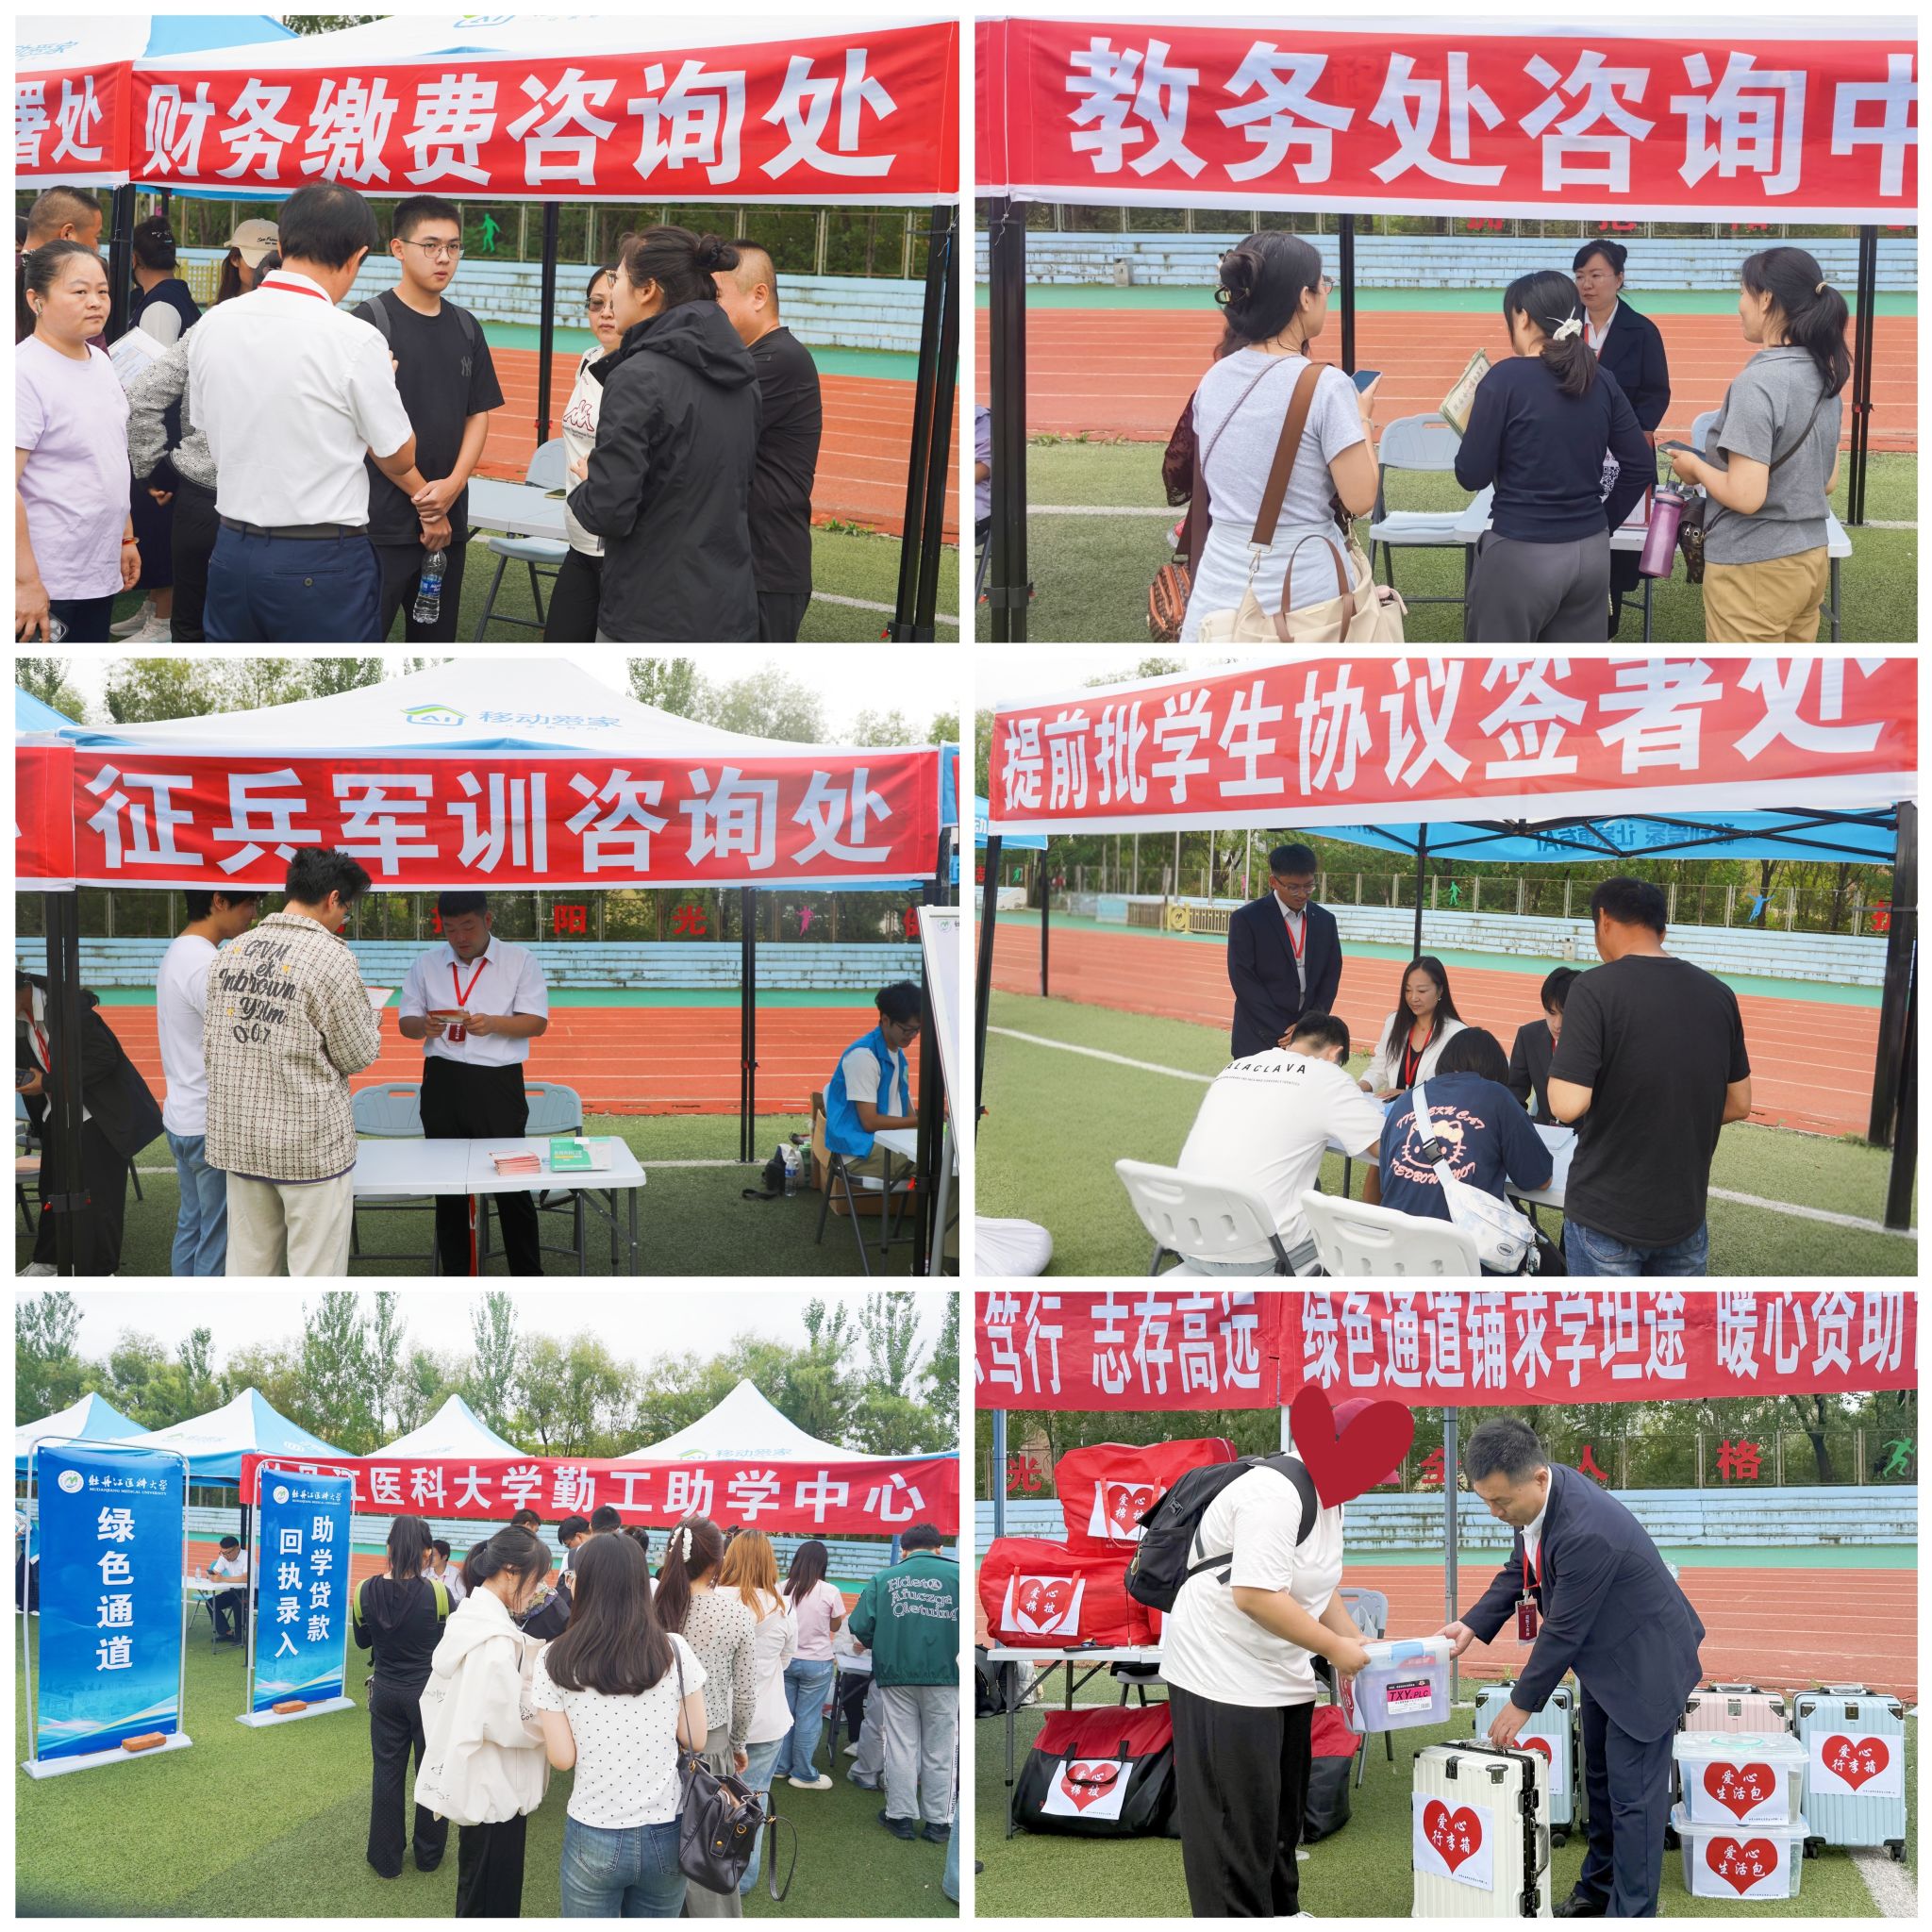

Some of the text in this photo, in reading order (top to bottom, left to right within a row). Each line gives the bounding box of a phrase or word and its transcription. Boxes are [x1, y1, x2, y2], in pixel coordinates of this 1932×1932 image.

[142, 48, 898, 186] 财务缴费咨询处
[1002, 658, 1887, 811] 提前批学生协议签署处
[84, 764, 893, 875] 征兵军训咨询处
[553, 905, 708, 935] 阳 光
[974, 1291, 1918, 1394] 笃行 志存高远 绿色通道铺求学坦途 暖心资助
[1007, 1456, 1041, 1491] 光
[1716, 1440, 1762, 1479] 格
[1119, 1493, 1146, 1507] 爱心
[96, 1507, 135, 1672] 绿色通道
[307, 1515, 334, 1642] 助学贷款
[275, 1528, 303, 1658] 回执录入
[1029, 1587, 1058, 1600] 爱心
[1025, 1600, 1056, 1614] 棉被
[1839, 1744, 1873, 1758] 爱心
[1832, 1758, 1876, 1774] 行李箱
[1722, 1770, 1758, 1785] 爱心
[1716, 1786, 1764, 1801] 生活包
[1437, 1813, 1467, 1832] 爱心
[1432, 1829, 1471, 1855] 行李箱
[1724, 1844, 1760, 1860] 爱心
[1718, 1860, 1766, 1877] 生活包
